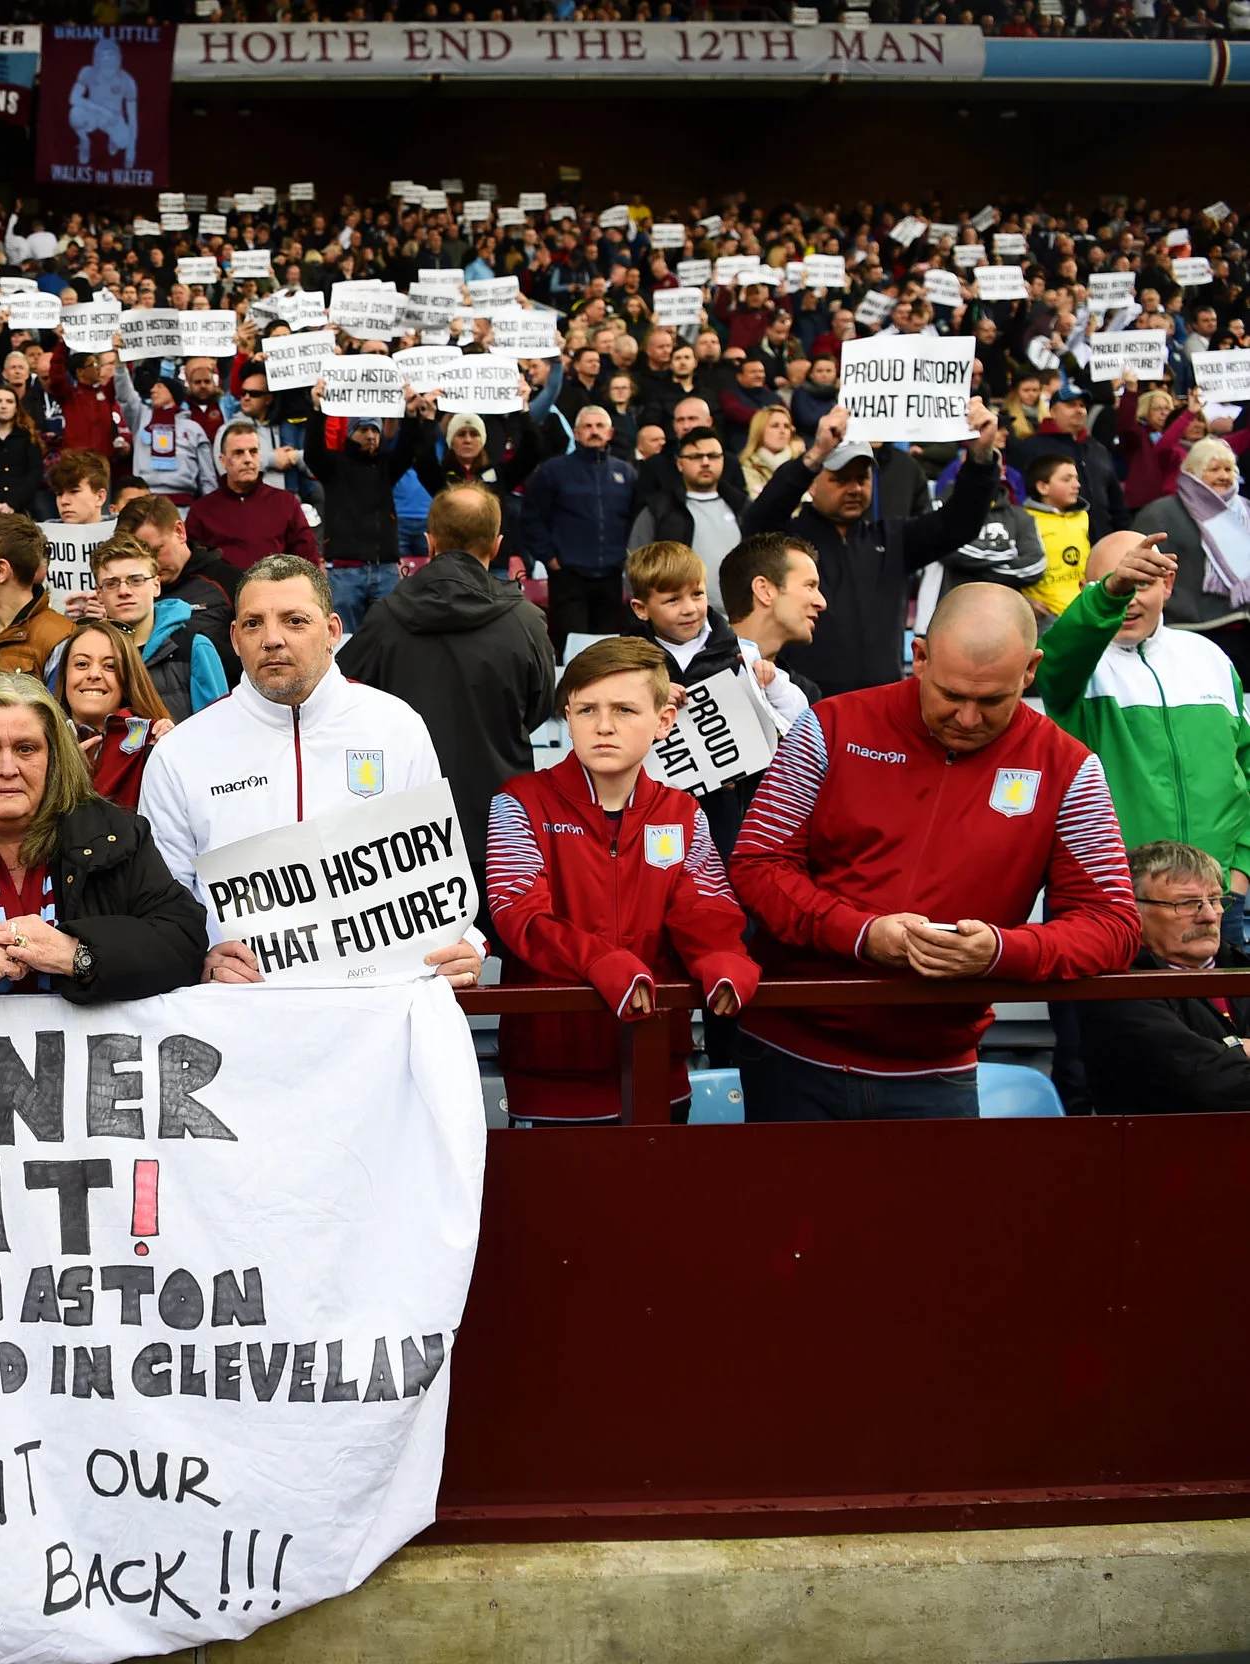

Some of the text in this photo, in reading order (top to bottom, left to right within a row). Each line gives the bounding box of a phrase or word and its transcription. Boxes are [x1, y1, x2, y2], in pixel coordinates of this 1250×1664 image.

[105, 25, 161, 43] LITTLE
[199, 27, 945, 66] HOLTE END THE 12TH MAN
[50, 163, 92, 184] WALKS
[111, 166, 155, 187] WATER
[321, 368, 358, 383] PROUD
[844, 358, 970, 385] PROUD HISTORY
[323, 388, 404, 404] WHAT FUTURE?
[844, 395, 899, 418] WHAT
[48, 541, 76, 562] OUD
[46, 570, 74, 591] HAT
[686, 685, 740, 768] PROUD
[351, 752, 381, 761] AVFC
[652, 722, 699, 778] HAT
[846, 742, 907, 764] macron
[210, 775, 268, 797] macron
[1001, 771, 1034, 782] AVFC
[650, 827, 679, 836] AVFC
[208, 816, 454, 923] PROUD HISTORY
[331, 876, 468, 958] FUTURE?
[347, 964, 377, 980] AVPG
[20, 1264, 266, 1330] ASTON
[50, 1344, 115, 1400] IN
[131, 1329, 459, 1403] CLEVELAN
[87, 1448, 222, 1508] OUR
[43, 1541, 201, 1619] BACK
